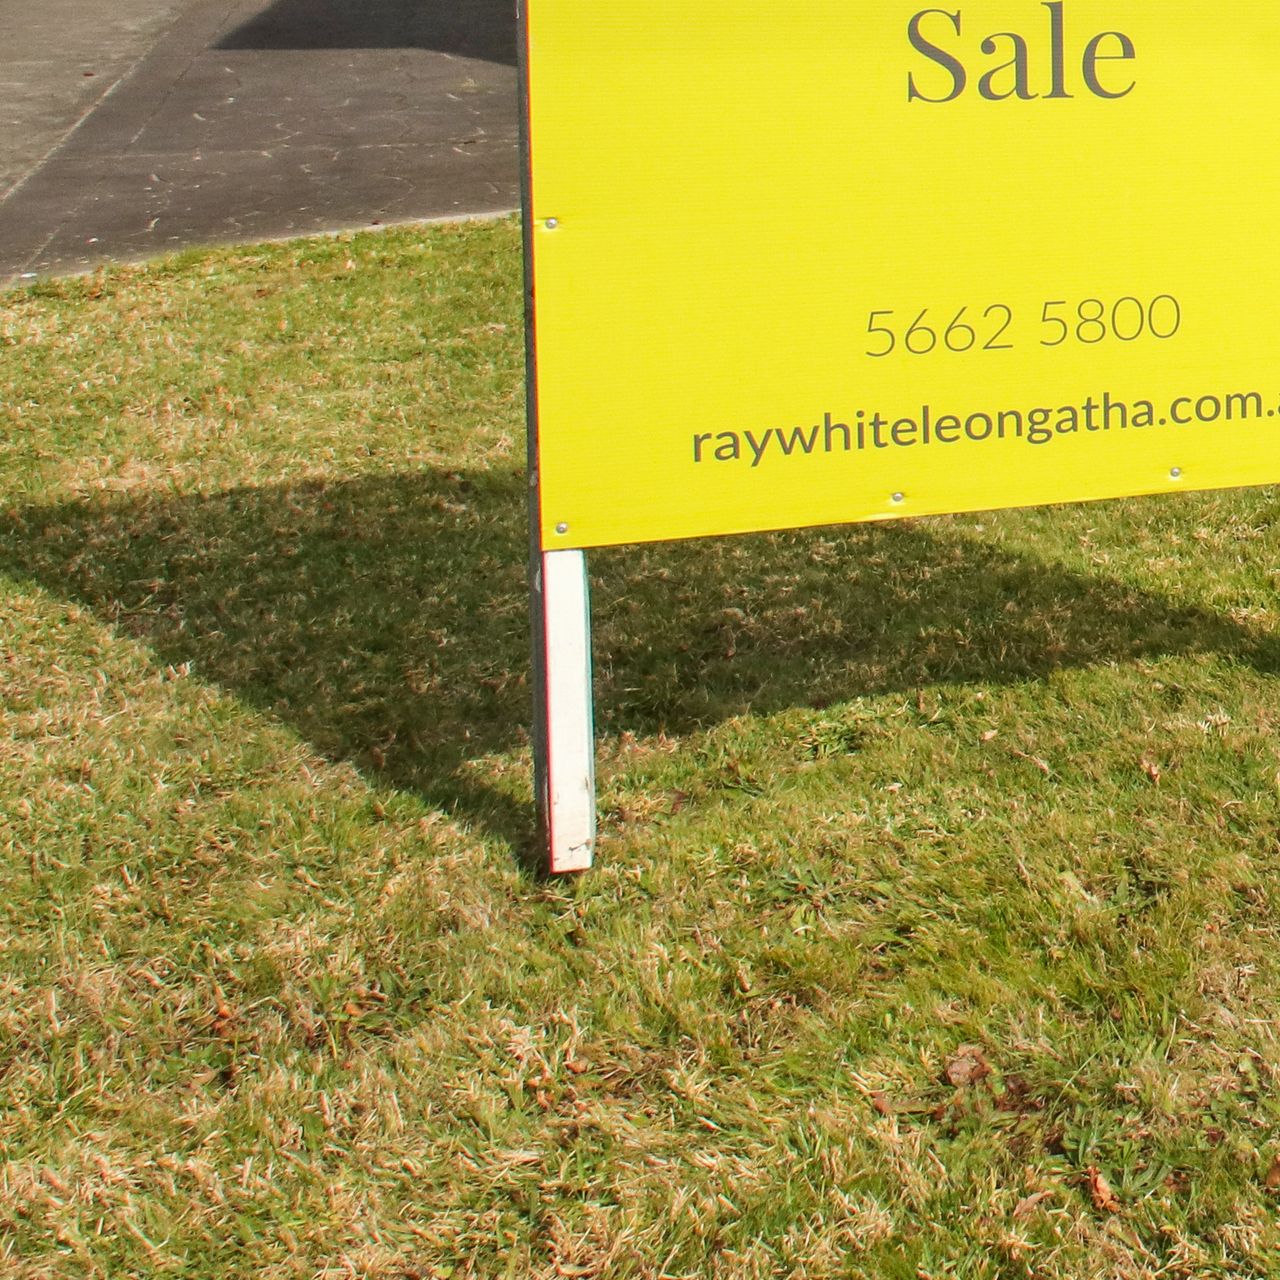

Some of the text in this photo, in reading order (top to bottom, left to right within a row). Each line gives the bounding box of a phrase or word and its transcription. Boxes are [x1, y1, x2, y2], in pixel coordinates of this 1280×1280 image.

[906, 0, 1137, 103] Sale
[864, 293, 1182, 358] 5662 5800
